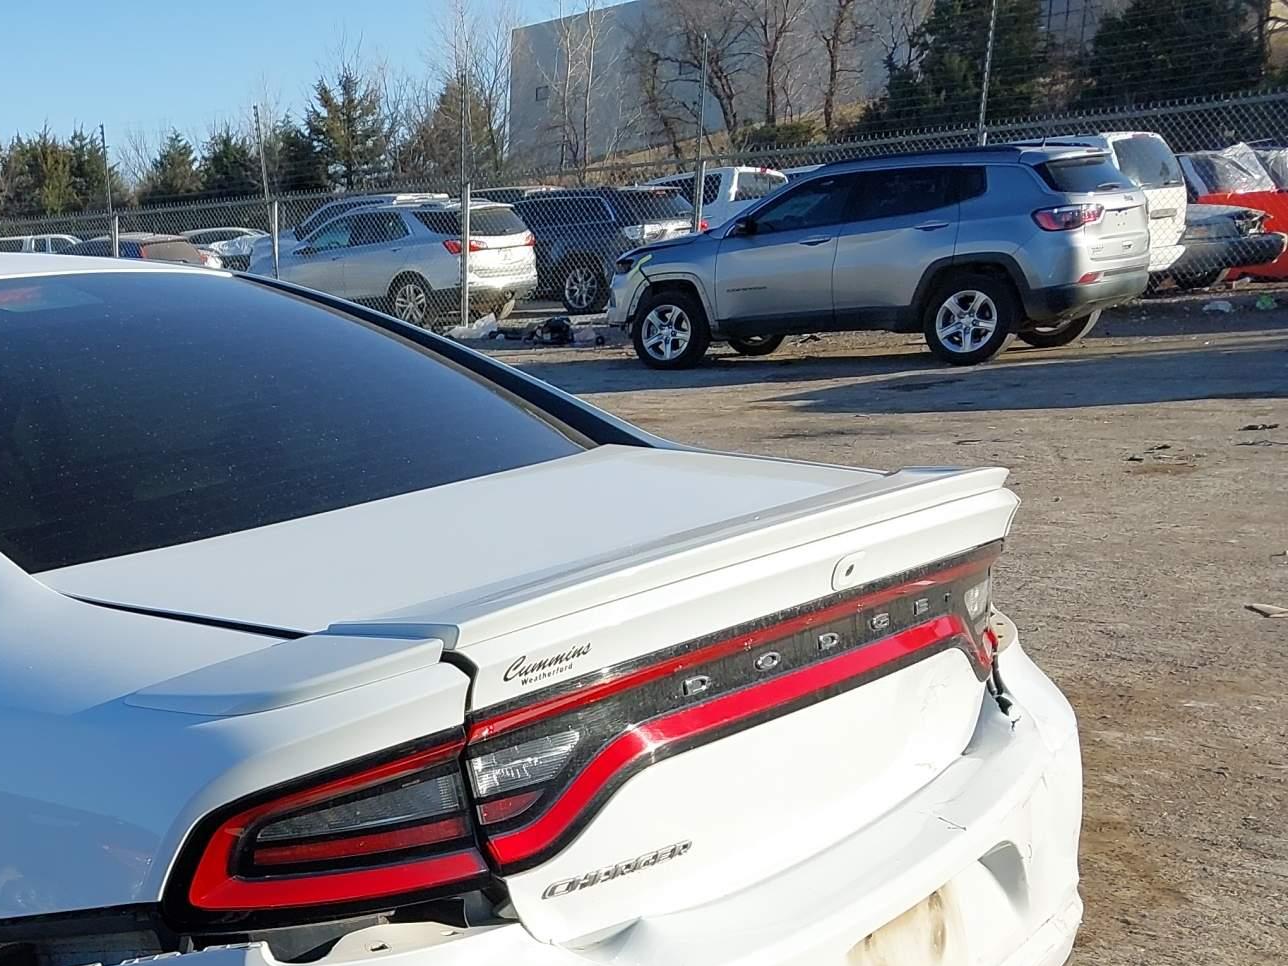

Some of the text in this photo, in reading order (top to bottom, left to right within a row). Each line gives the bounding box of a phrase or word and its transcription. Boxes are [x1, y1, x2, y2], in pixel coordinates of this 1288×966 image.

[502, 642, 592, 682] Cummins
[681, 598, 929, 697] DODGE
[520, 663, 574, 687] Weatherford
[541, 840, 693, 900] CHARGER
